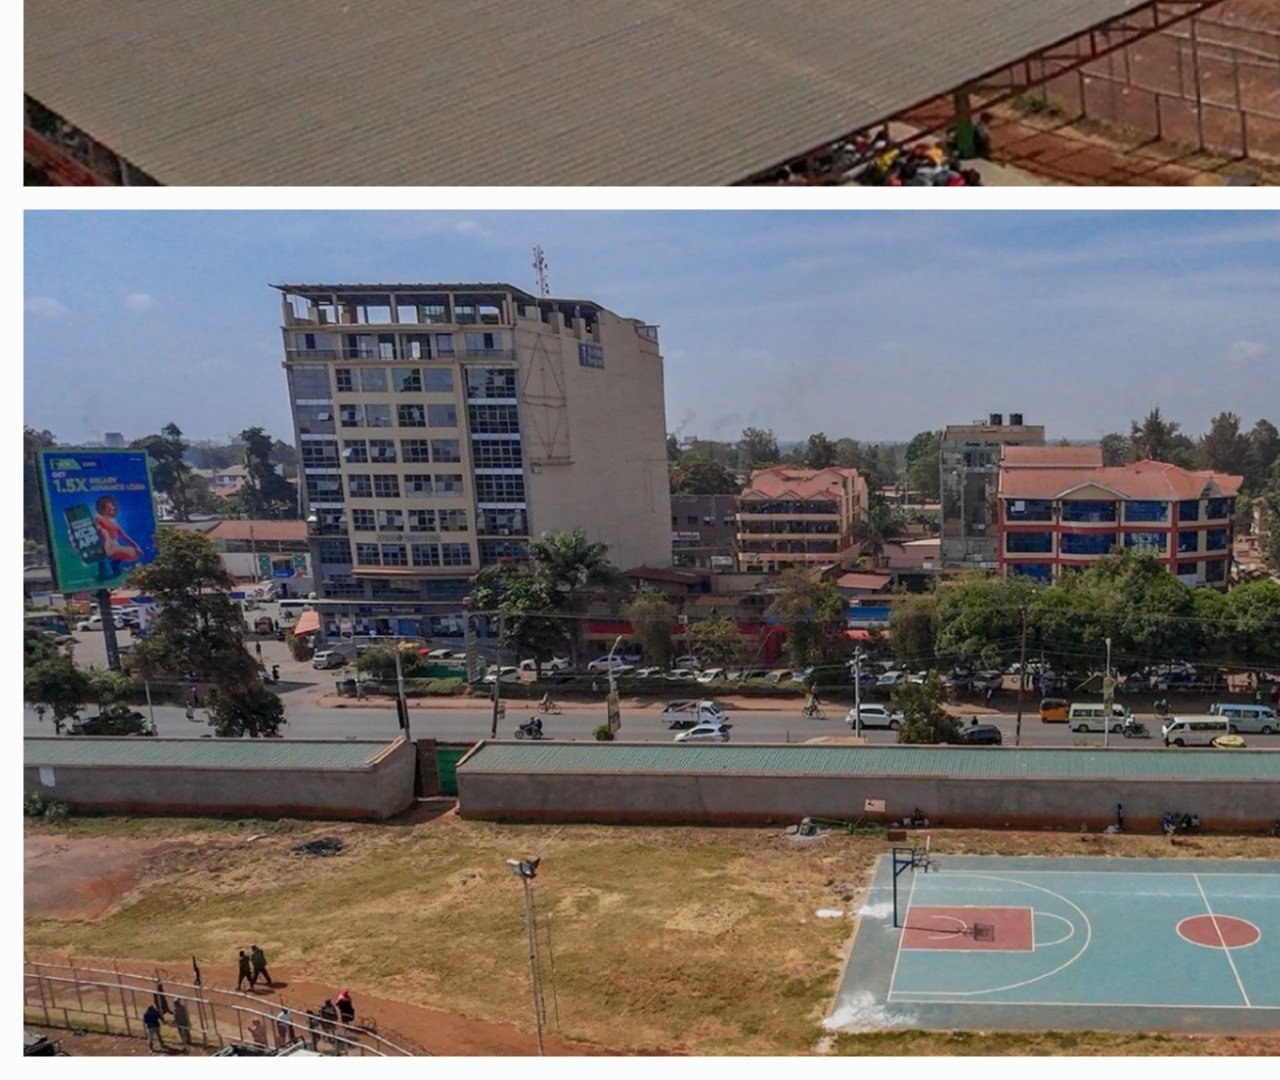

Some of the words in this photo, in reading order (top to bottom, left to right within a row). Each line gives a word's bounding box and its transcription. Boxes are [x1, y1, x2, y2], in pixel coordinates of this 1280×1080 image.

[53, 478, 88, 493] 1.5X
[74, 525, 97, 540] KCB
[79, 535, 99, 550] APP
